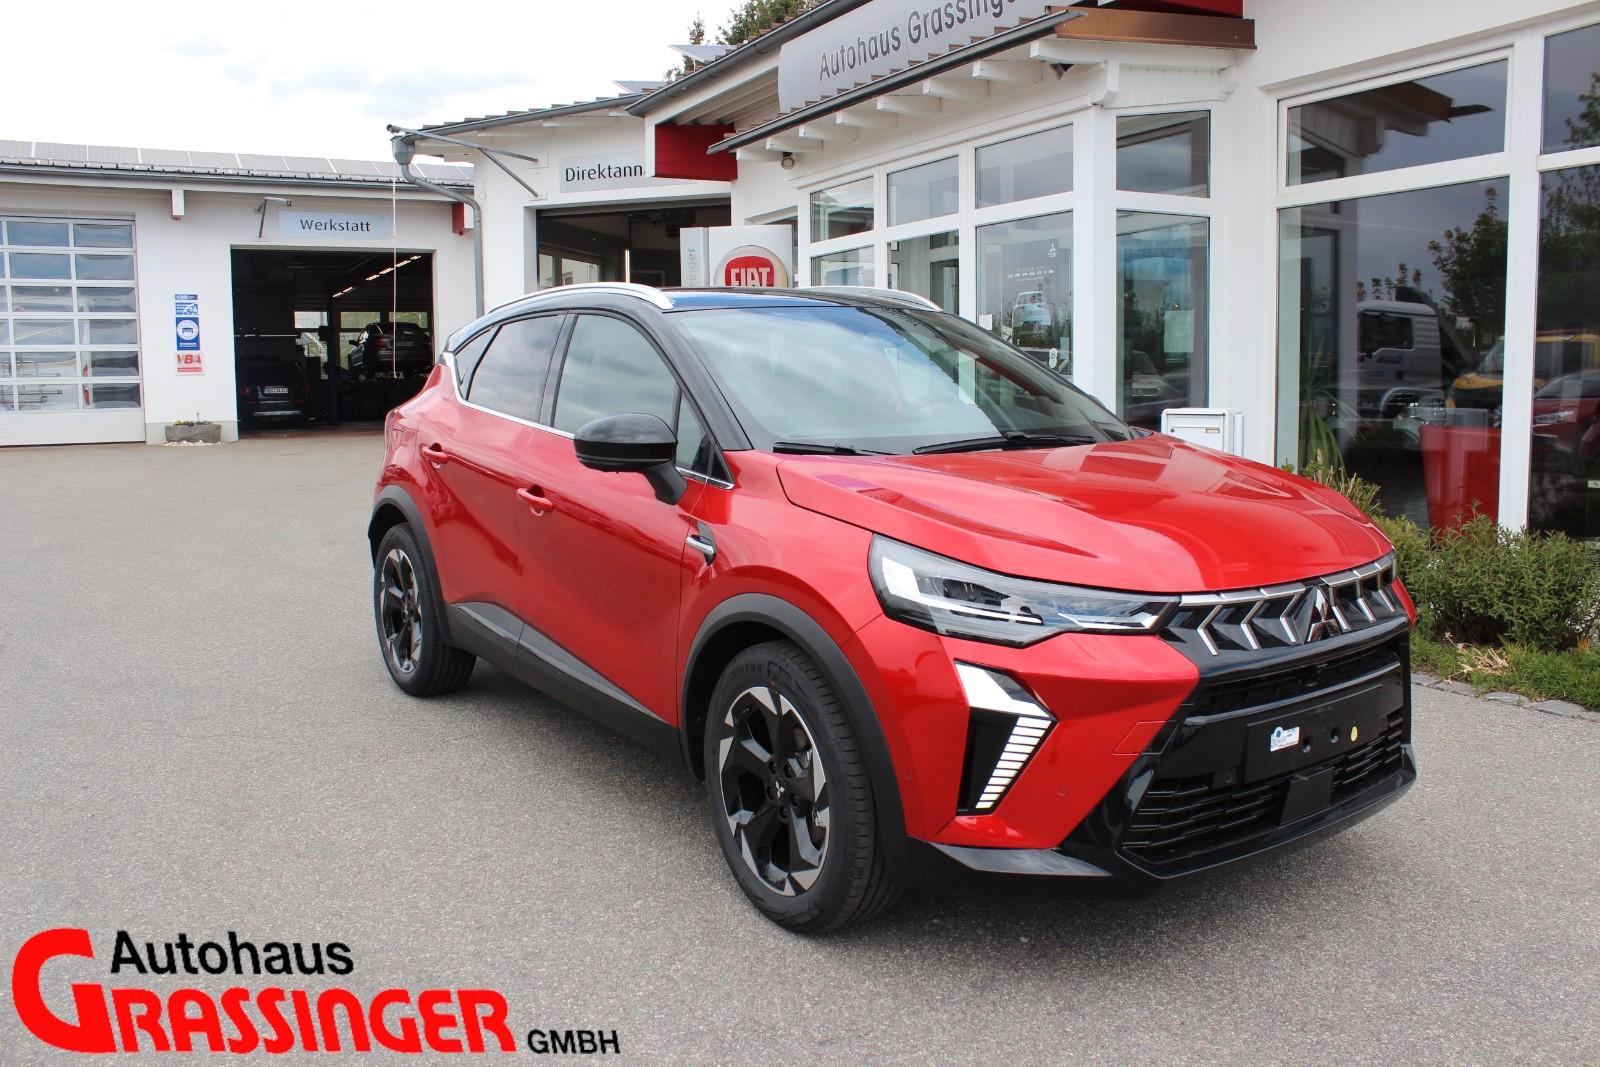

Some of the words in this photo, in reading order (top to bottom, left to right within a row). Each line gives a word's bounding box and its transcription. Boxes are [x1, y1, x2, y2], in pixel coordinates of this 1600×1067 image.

[819, 25, 901, 81] Autohaus
[907, 0, 1015, 44] Grassing
[565, 164, 645, 182] Direktann
[300, 218, 371, 232] Werkstatt
[730, 267, 771, 287] FIAT
